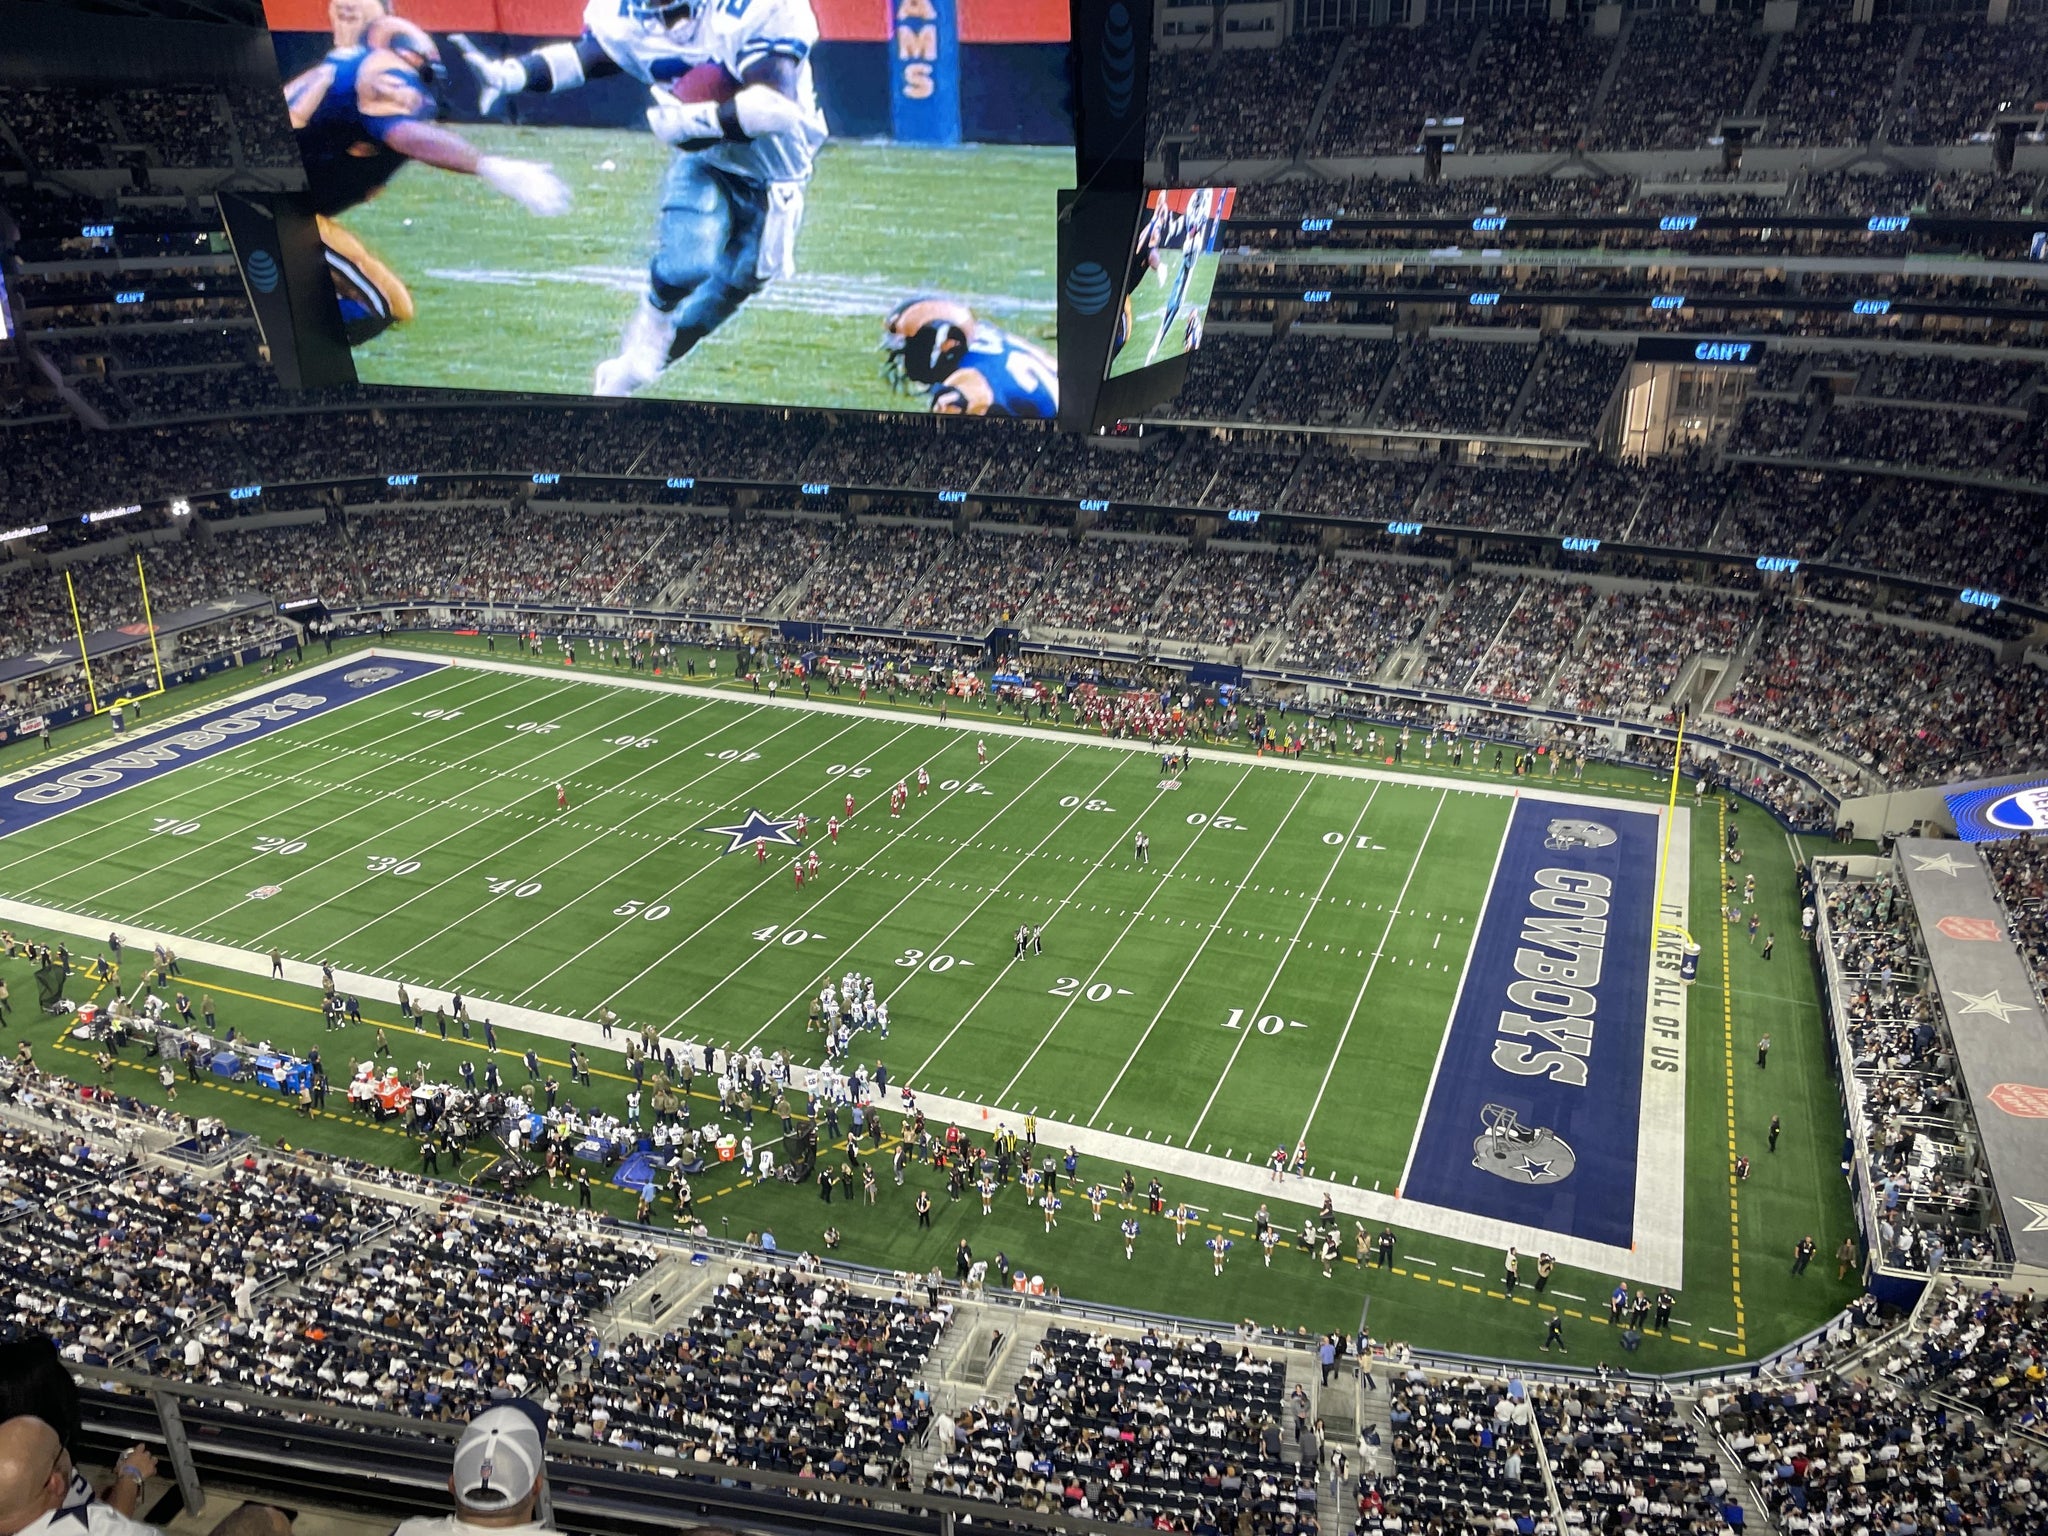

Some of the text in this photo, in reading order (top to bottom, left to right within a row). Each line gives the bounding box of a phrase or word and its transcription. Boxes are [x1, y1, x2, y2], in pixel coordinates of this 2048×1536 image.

[81, 225, 114, 237] CAN'T
[1301, 219, 1334, 231] CAN'T
[1472, 217, 1506, 230] CAN'T
[1659, 216, 1698, 231] CAN'T
[1867, 216, 1910, 232] CAN'T
[115, 293, 145, 303] CAN'T
[1304, 291, 1332, 302] CAN'T
[1469, 294, 1500, 305] CAN'T
[1651, 296, 1685, 309] CAN'T
[1852, 300, 1891, 314] CAN'T
[1693, 343, 1752, 362] CAN'T
[387, 475, 419, 486] CAN'T
[532, 474, 561, 485] CAN'T
[666, 478, 695, 488] CAN'T
[229, 486, 262, 500] CAN'T
[801, 483, 830, 494] CAN'T
[938, 491, 968, 502] CAN'T
[1079, 500, 1110, 512] CAN'T
[1227, 510, 1261, 523] CAN'T
[1387, 521, 1423, 536] CAN'T
[1561, 536, 1601, 552] CAN'T
[1755, 555, 1800, 573] CAN'T
[1959, 588, 2001, 610] CAN'T
[422, 709, 464, 721] 10
[516, 722, 561, 734] 20
[14, 693, 326, 803] COWBOYS
[614, 735, 659, 749] 30
[717, 749, 761, 763] 40
[825, 764, 871, 778] 50
[939, 779, 985, 794] 40
[1059, 796, 1107, 811] 30
[149, 818, 201, 836] 10
[1186, 813, 1236, 829] 20
[252, 837, 308, 856] 20
[1322, 831, 1372, 849] 10
[366, 857, 421, 876] 30
[487, 879, 542, 897] 40
[613, 900, 671, 921] 50
[1660, 903, 1683, 918] IT
[751, 925, 808, 946] 40
[894, 949, 955, 973] 30
[1491, 868, 1611, 1087] COWBOYS
[1047, 977, 1113, 1002] 20
[1653, 976, 1680, 1006] ALL
[1220, 1008, 1284, 1036] 10
[1652, 1015, 1679, 1040] OF
[1650, 1046, 1679, 1073] US
